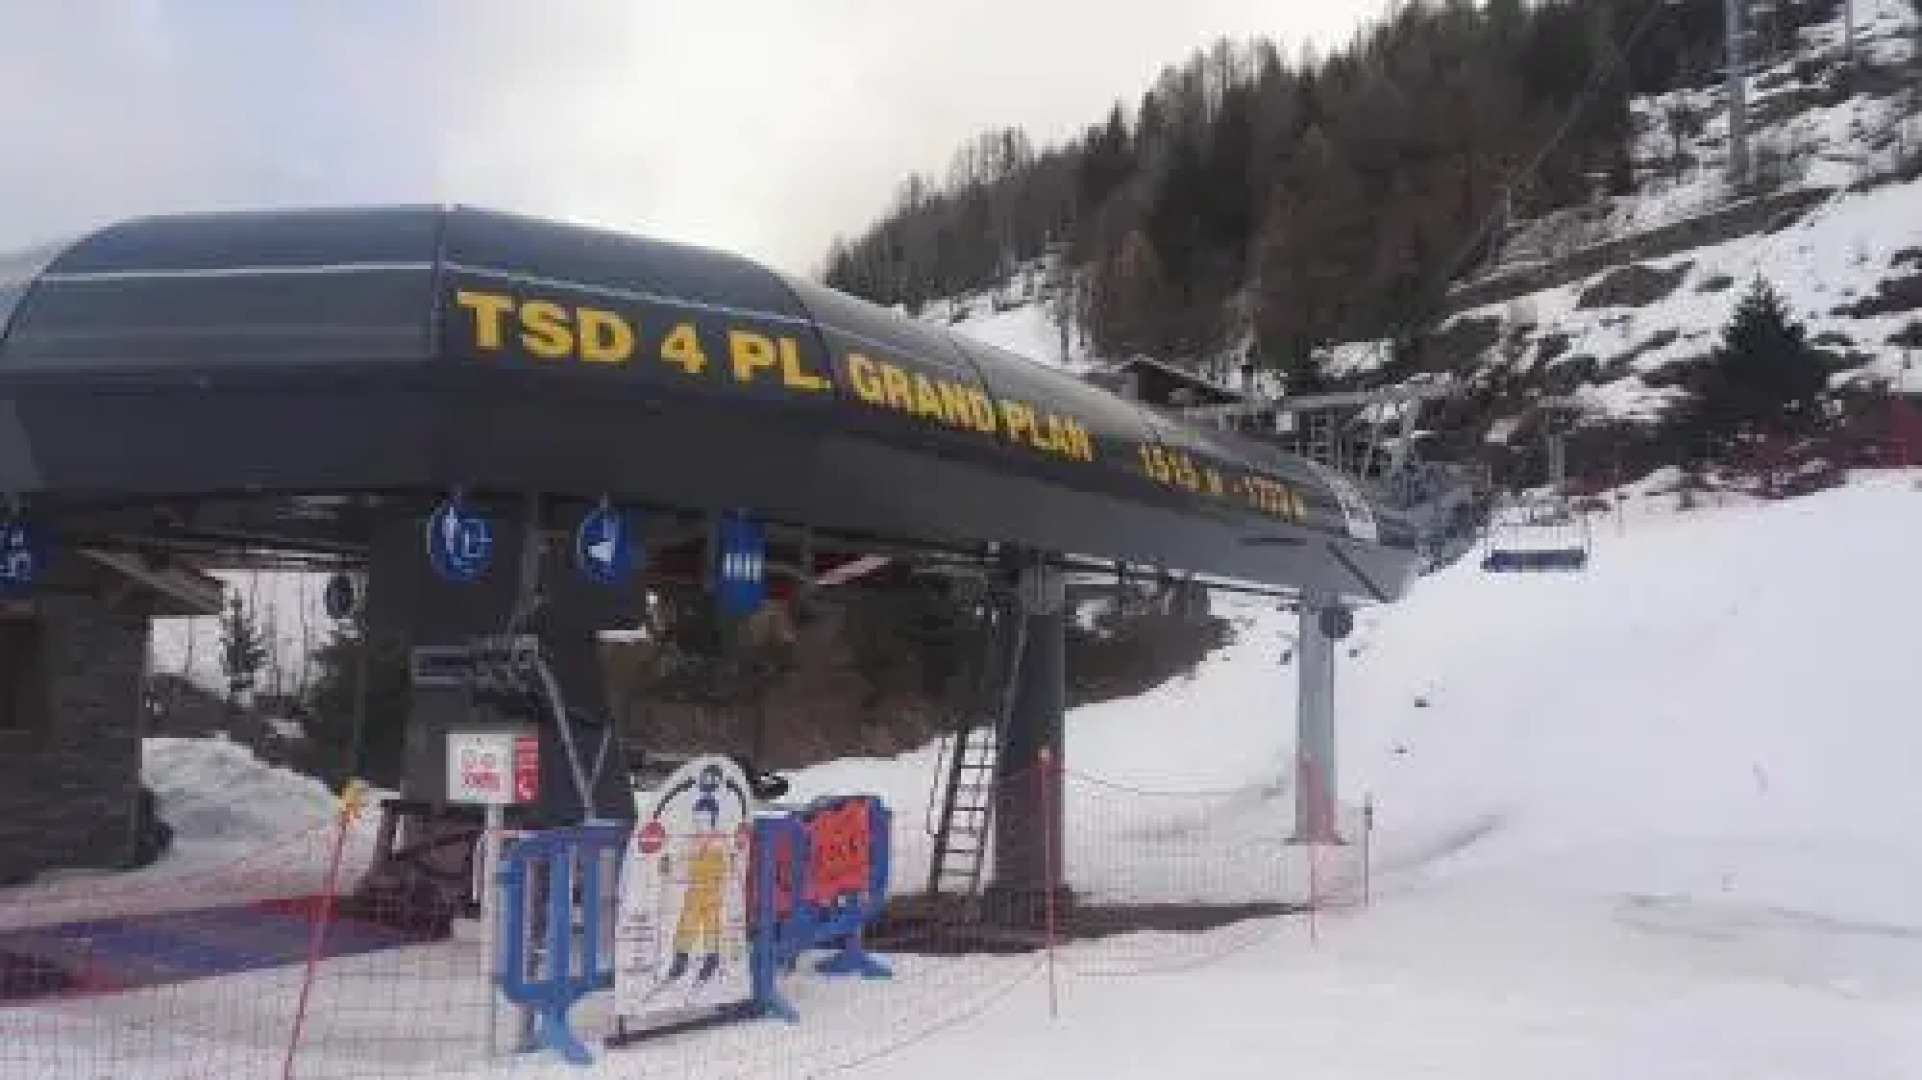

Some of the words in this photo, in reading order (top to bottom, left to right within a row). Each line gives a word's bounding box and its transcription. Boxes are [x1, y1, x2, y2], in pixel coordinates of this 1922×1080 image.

[457, 290, 636, 363] TSD
[659, 323, 707, 374] 4
[848, 352, 996, 431] GRAND
[1000, 399, 1093, 462] PLAN
